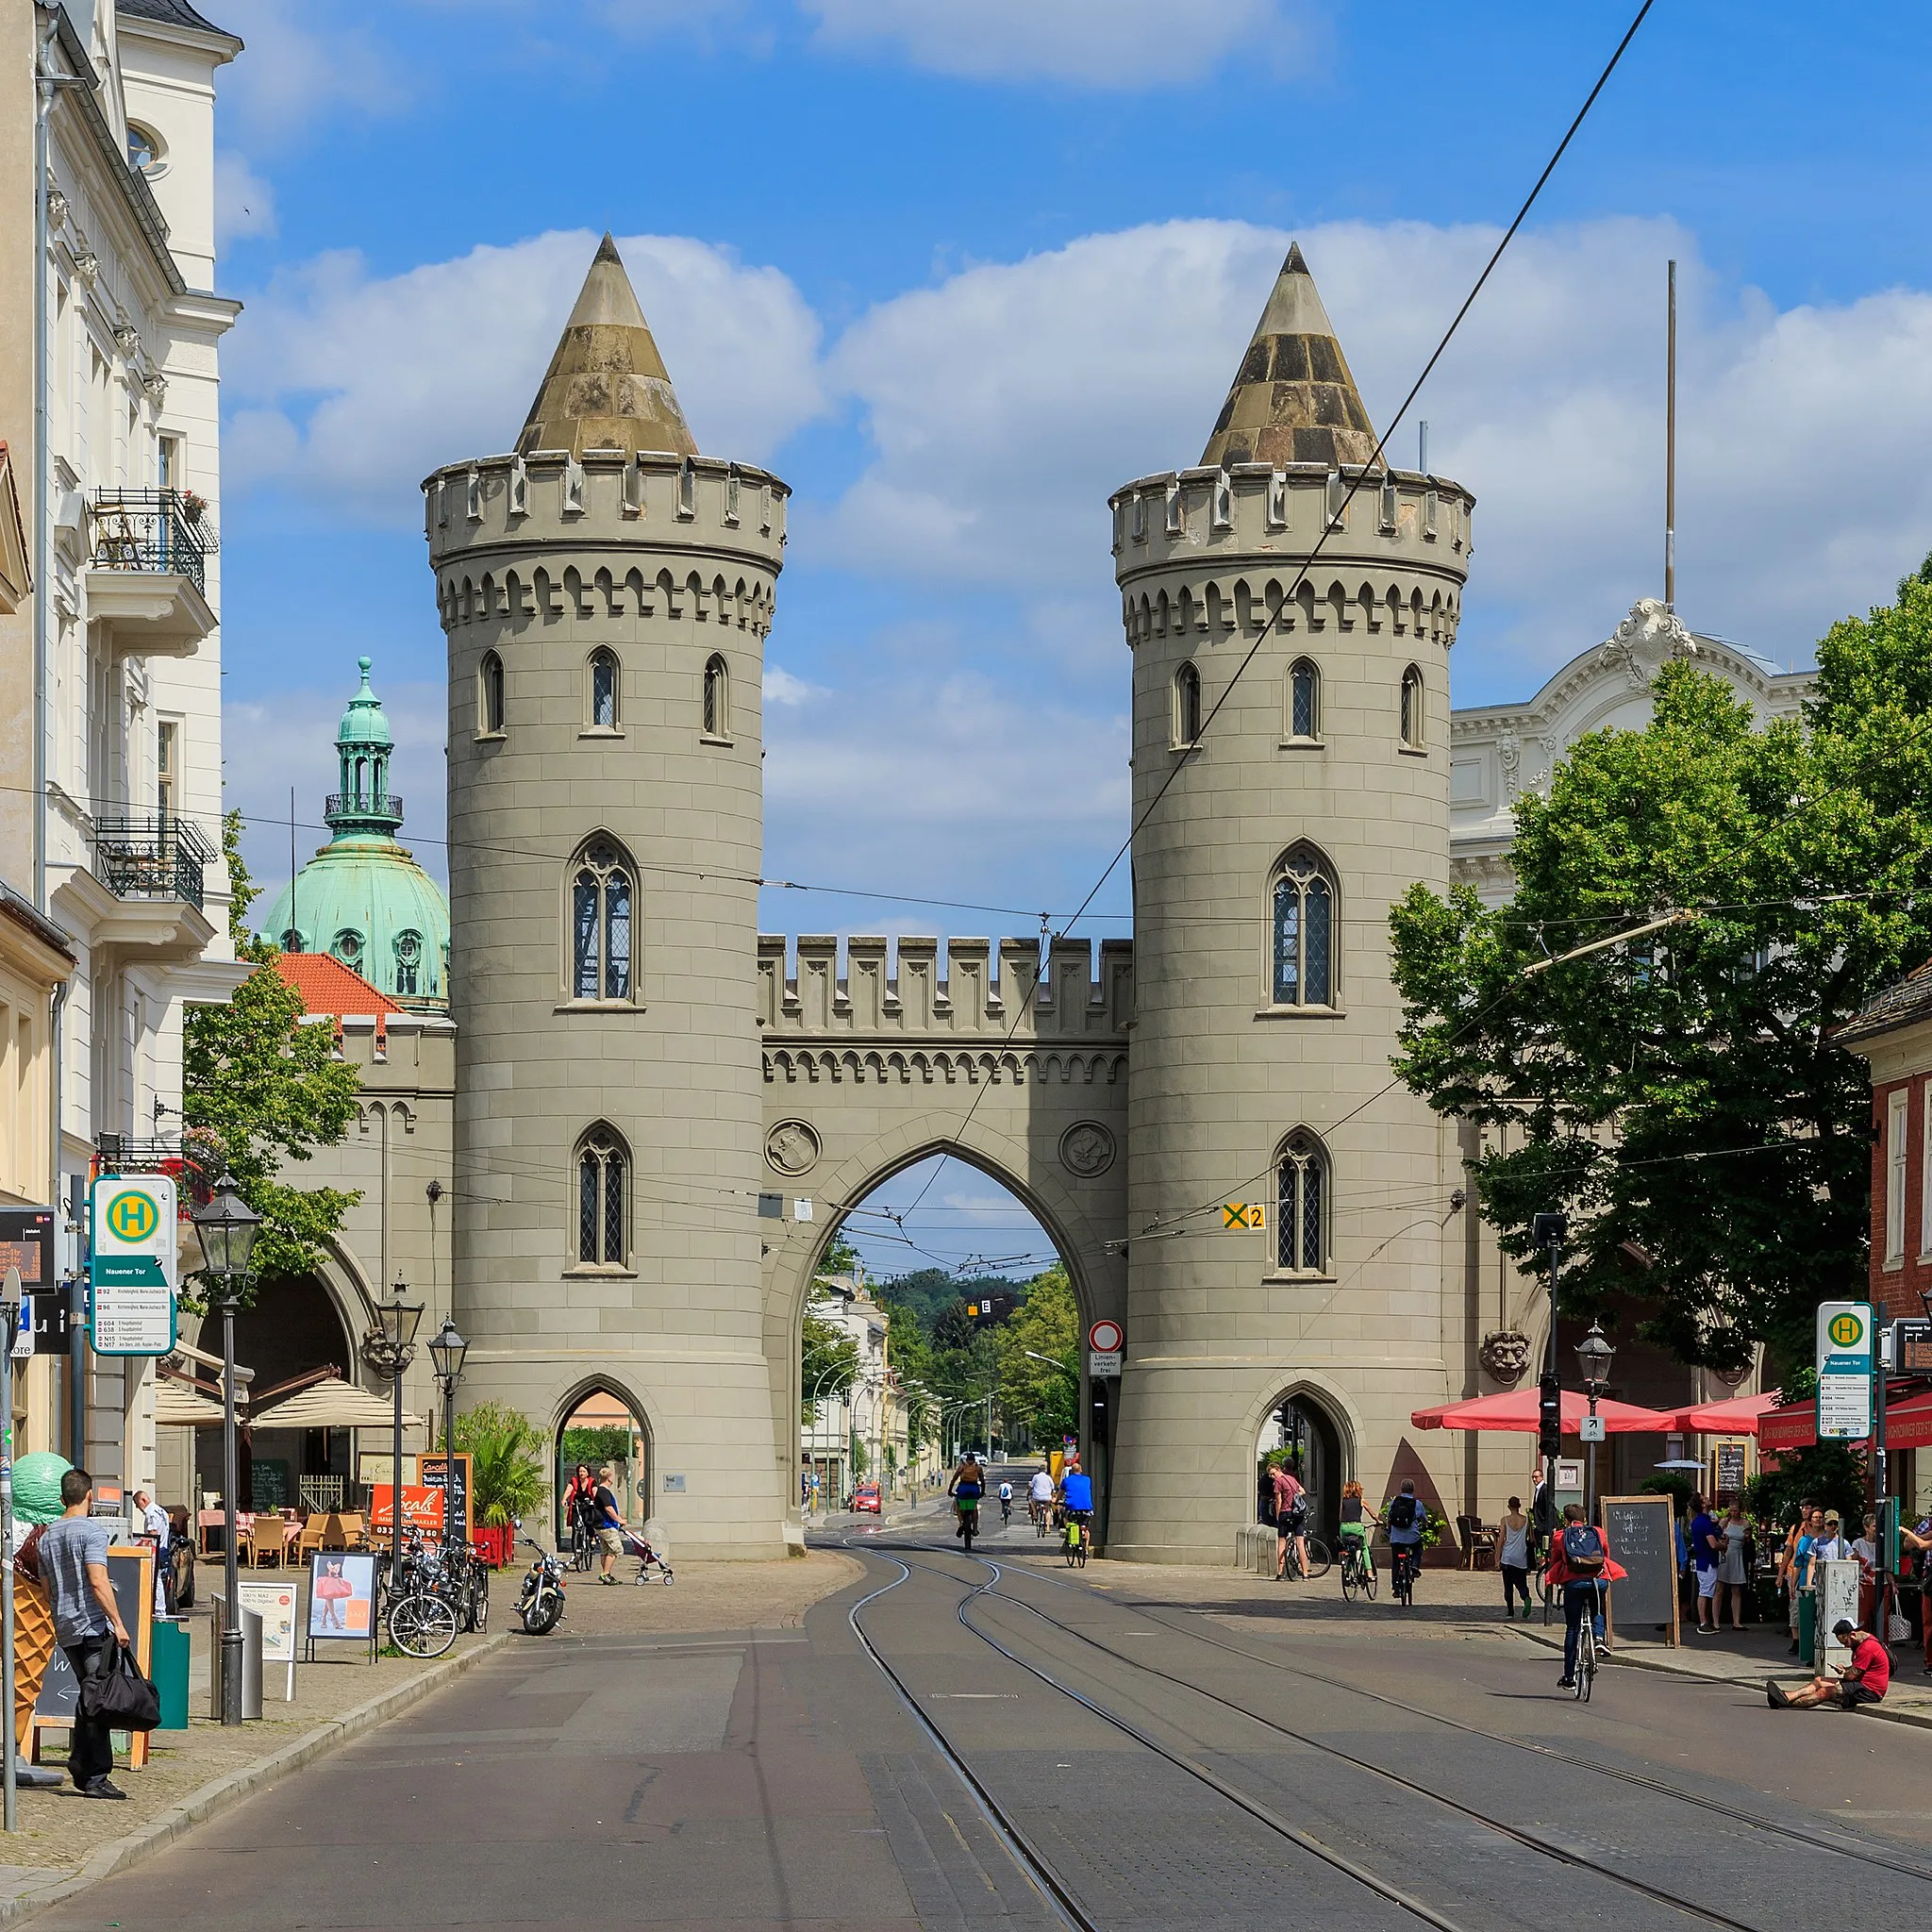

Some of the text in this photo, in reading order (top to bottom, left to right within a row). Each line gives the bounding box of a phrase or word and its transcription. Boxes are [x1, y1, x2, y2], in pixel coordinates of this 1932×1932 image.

[121, 1203, 145, 1230] H
[1252, 1209, 1261, 1226] 2
[1839, 1321, 1853, 1340] H
